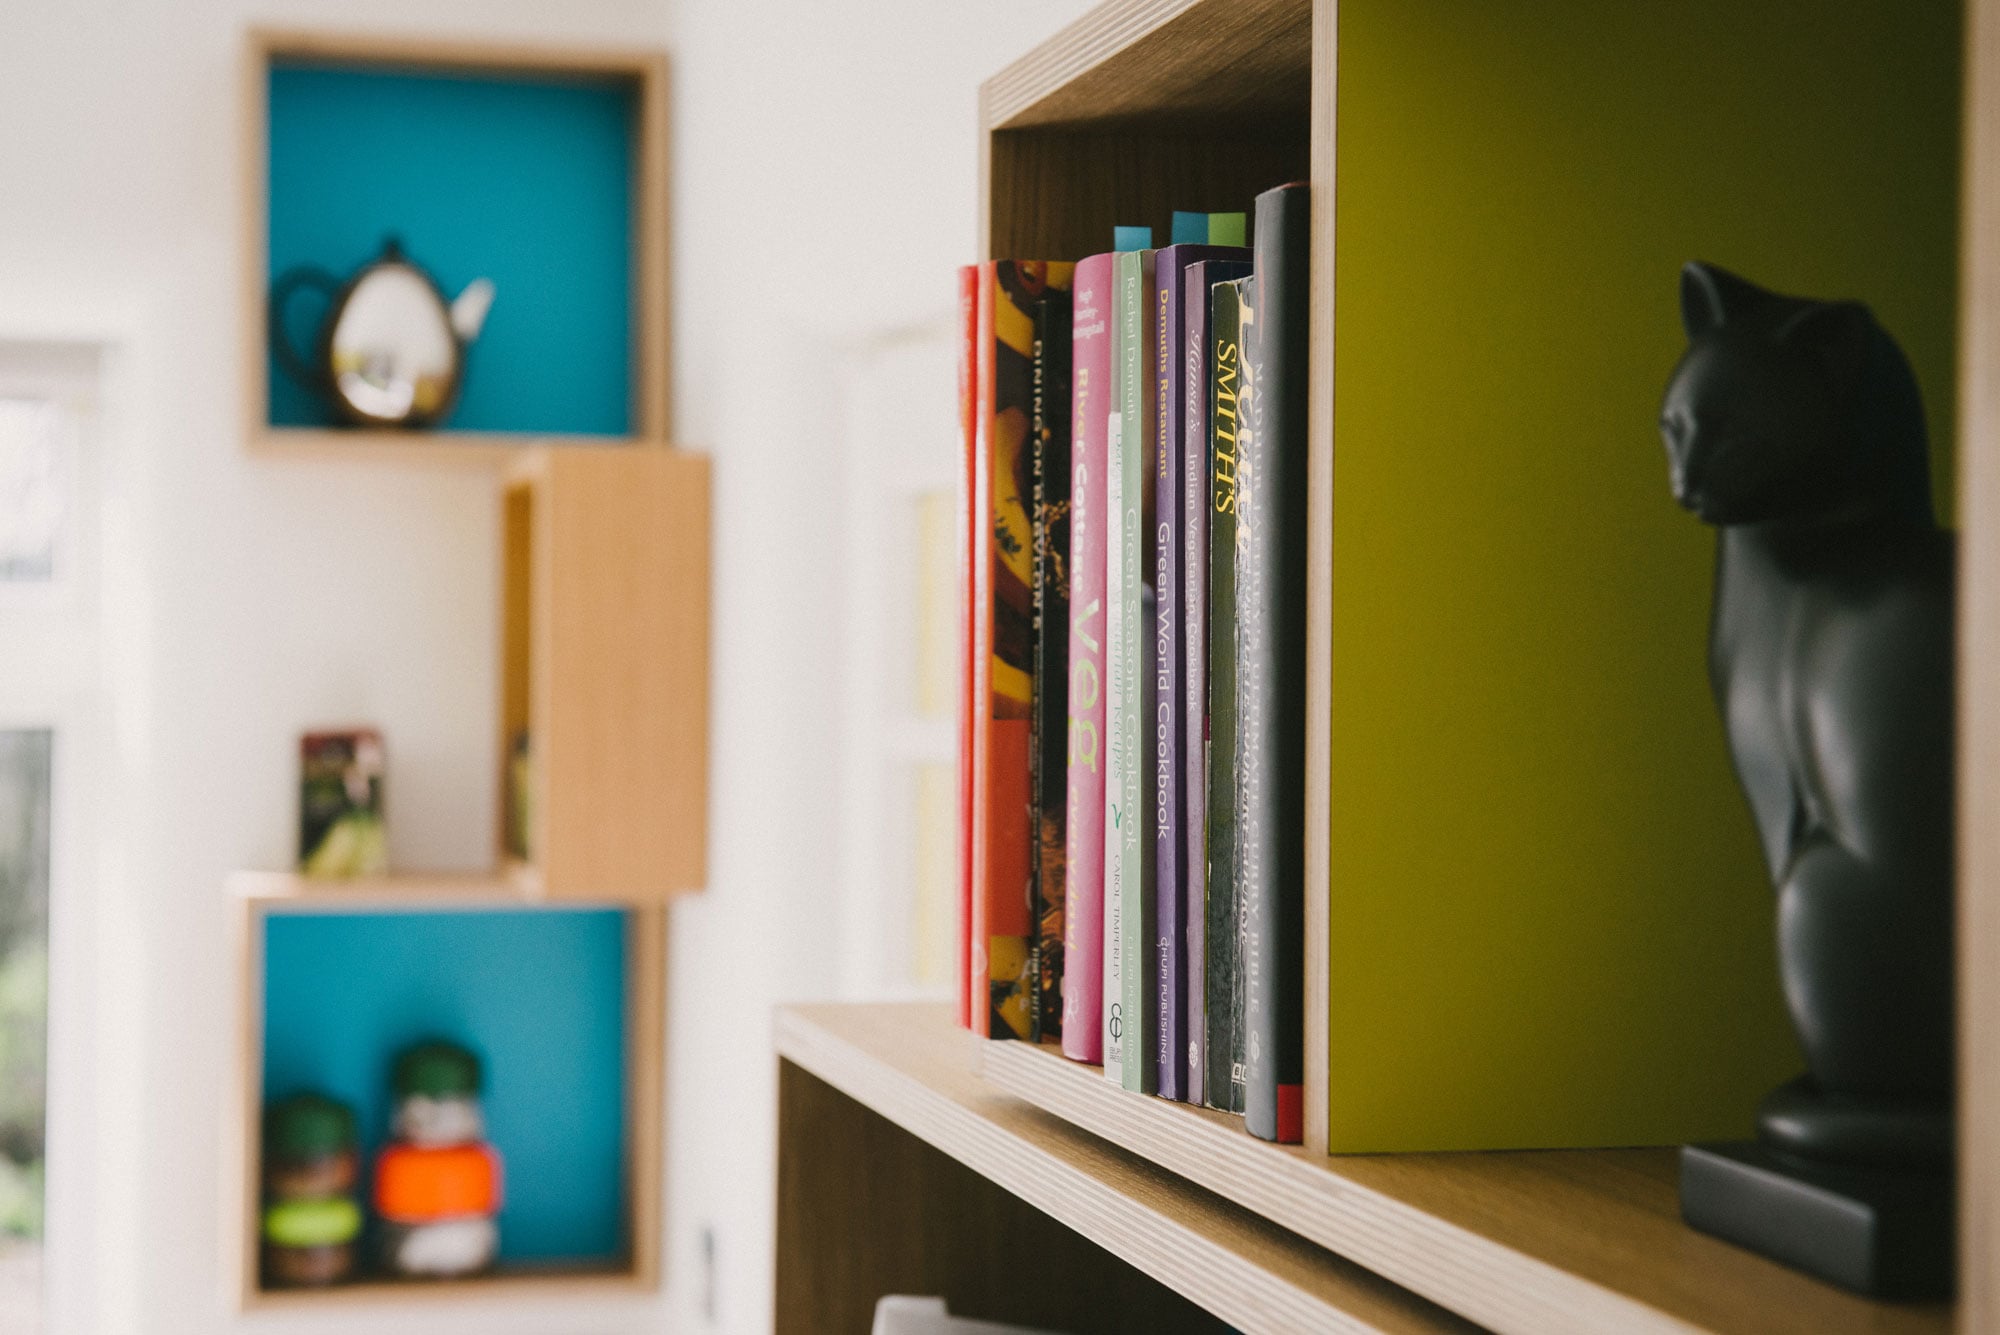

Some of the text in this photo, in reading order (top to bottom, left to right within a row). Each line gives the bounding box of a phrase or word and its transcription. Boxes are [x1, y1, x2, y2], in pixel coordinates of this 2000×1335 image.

[1033, 340, 1043, 432] DINING
[1076, 368, 1089, 453] River
[1126, 276, 1135, 421] Rachel Demuth
[1160, 289, 1168, 479] Demuths Restaurant
[1033, 439, 1042, 476] ON
[1216, 340, 1238, 514] SMITH'S
[1254, 363, 1263, 491] MADHUR
[1072, 463, 1087, 592] Cottage
[1187, 329, 1200, 712] Hansa's Indian Vegetarian Cookbook
[1067, 598, 1099, 774] Veg
[1126, 508, 1136, 852] Green Seasons Cookbook
[1158, 522, 1170, 839] Green World Cookbook
[1251, 820, 1260, 920] CURRY
[1160, 984, 1168, 1065] PUBLISHING
[1251, 932, 1260, 1014] BIBLE
